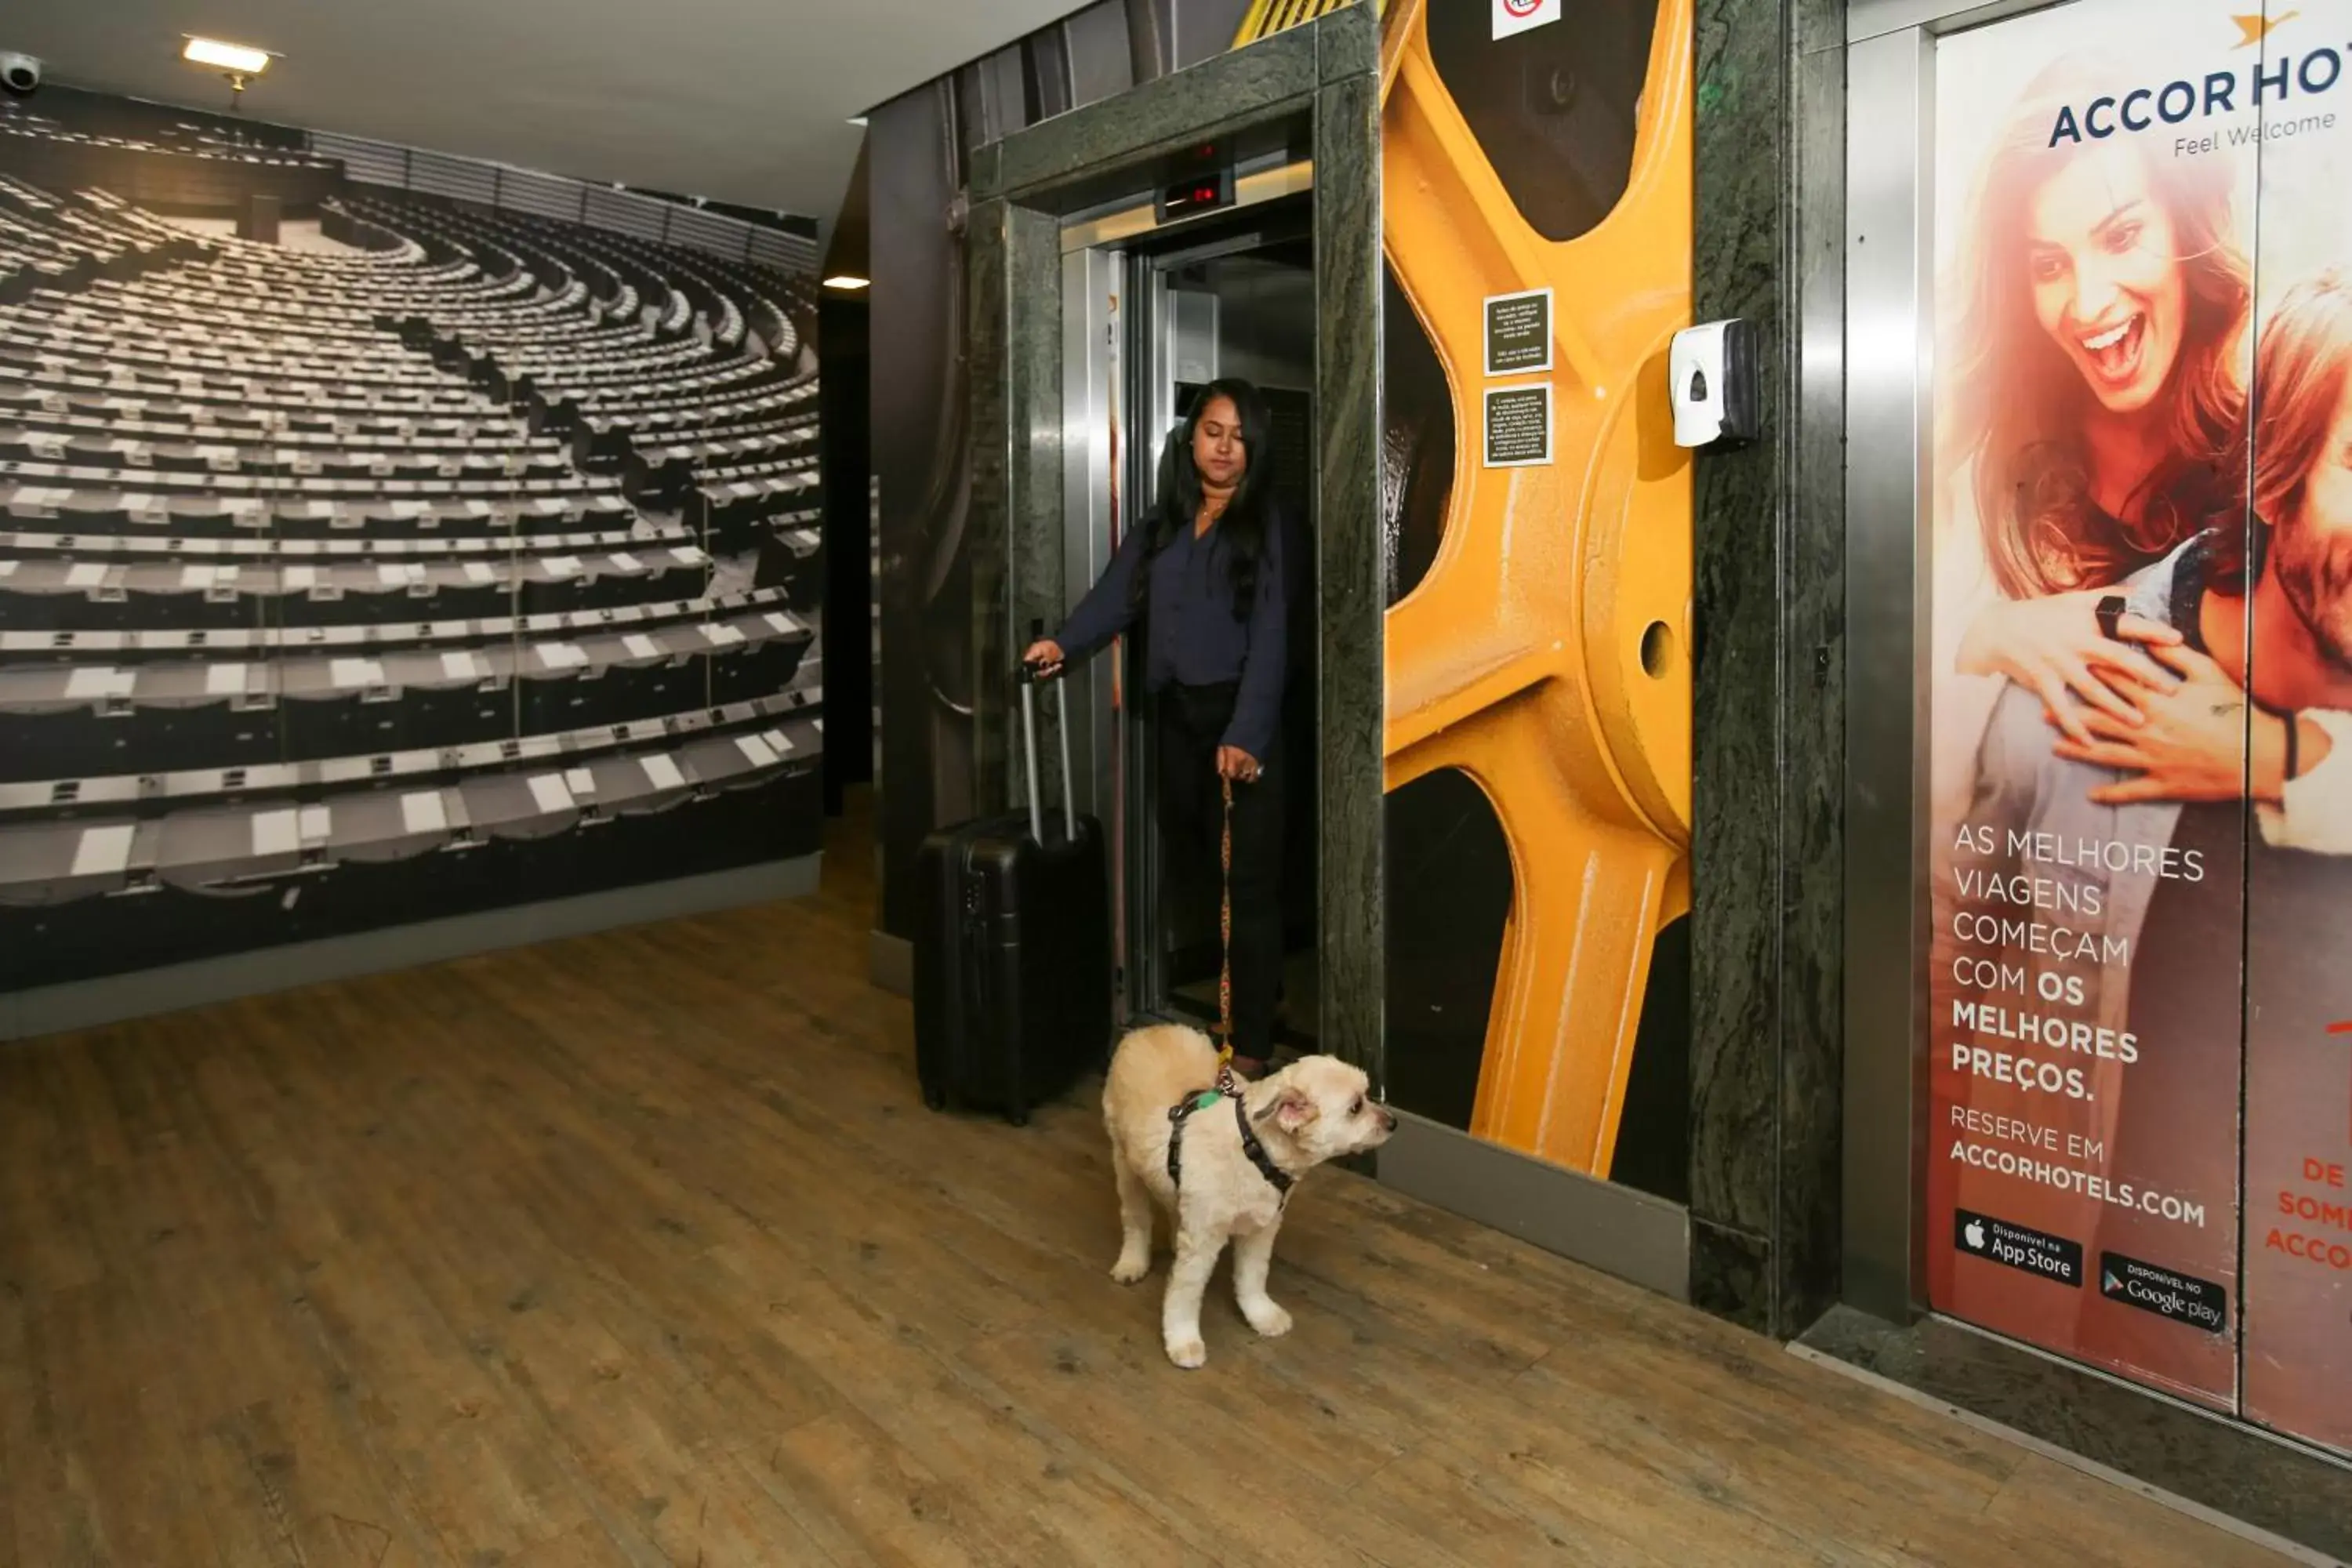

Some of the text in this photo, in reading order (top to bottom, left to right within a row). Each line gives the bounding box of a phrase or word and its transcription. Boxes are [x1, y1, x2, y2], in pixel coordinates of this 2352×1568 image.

[2047, 42, 2352, 148] ACCOR HO
[2173, 113, 2336, 157] Feel Welcome
[1954, 823, 2205, 882] AS MELHORES
[1954, 867, 2101, 916] VIAGENS
[1953, 912, 2128, 966] COMEÇAM
[1953, 956, 2085, 1006] COM OS
[1952, 999, 2139, 1064] MELHORES
[1951, 1044, 2094, 1102] PREÇOS.
[1951, 1105, 2104, 1162] RESERVE EM
[1950, 1141, 2205, 1228] ACCORHOTELS.COM
[2303, 1156, 2345, 1189] DE
[1992, 1239, 2071, 1277] App Store
[2127, 1264, 2201, 1294] DISPONÍVEL NO
[2127, 1279, 2222, 1325] Google play
